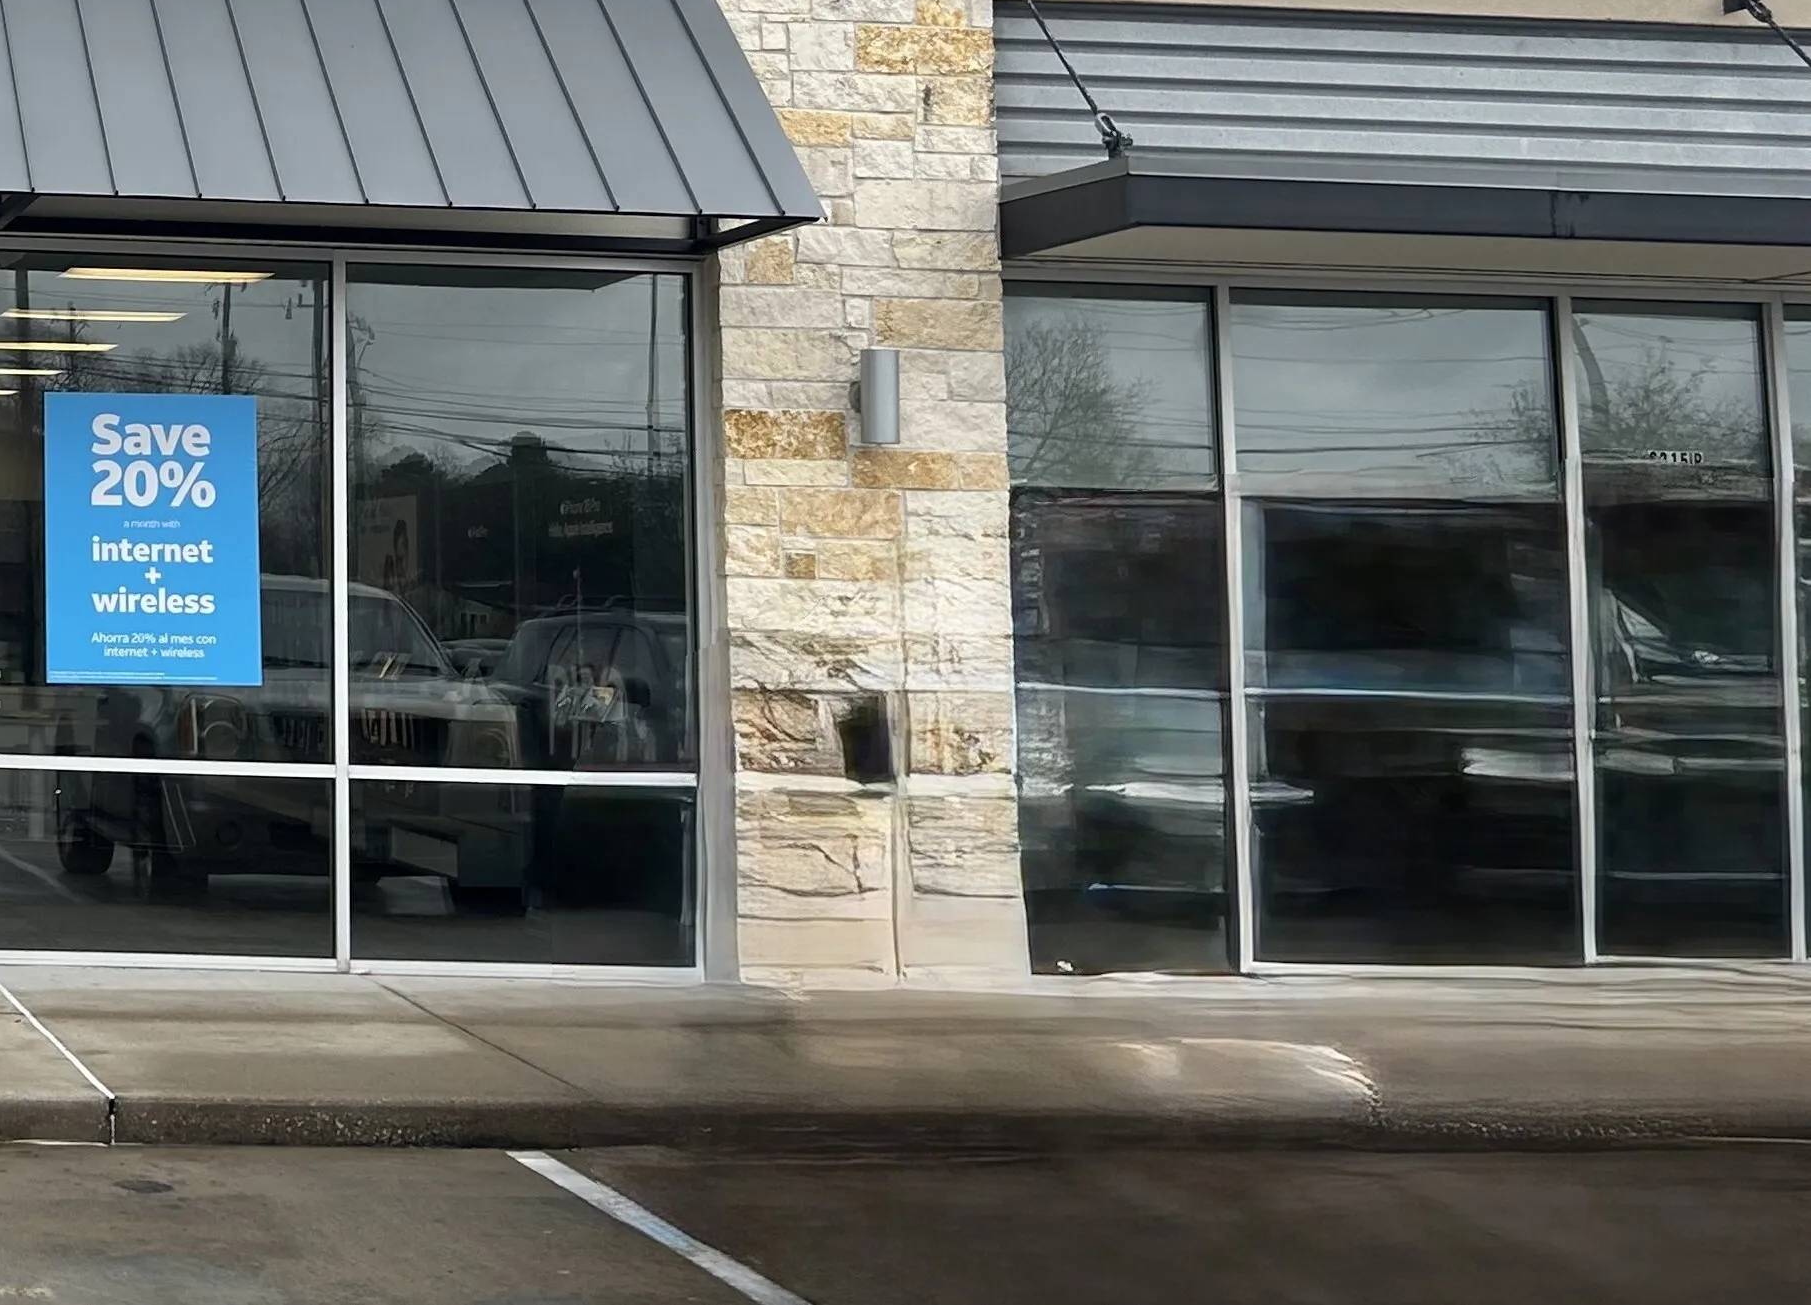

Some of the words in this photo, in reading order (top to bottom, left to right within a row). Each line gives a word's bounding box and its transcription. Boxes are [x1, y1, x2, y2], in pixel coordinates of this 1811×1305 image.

[91, 413, 211, 456] Save
[91, 459, 216, 508] 20%
[131, 520, 160, 528] month
[161, 520, 181, 528] with
[92, 535, 214, 563] internet
[91, 586, 215, 614] wireless
[91, 632, 129, 643] Ahorra
[131, 633, 156, 644] 20%
[158, 632, 168, 644] al
[170, 635, 194, 645] mes
[195, 635, 217, 645] con
[103, 646, 148, 657] internet
[160, 647, 205, 658] wireless
